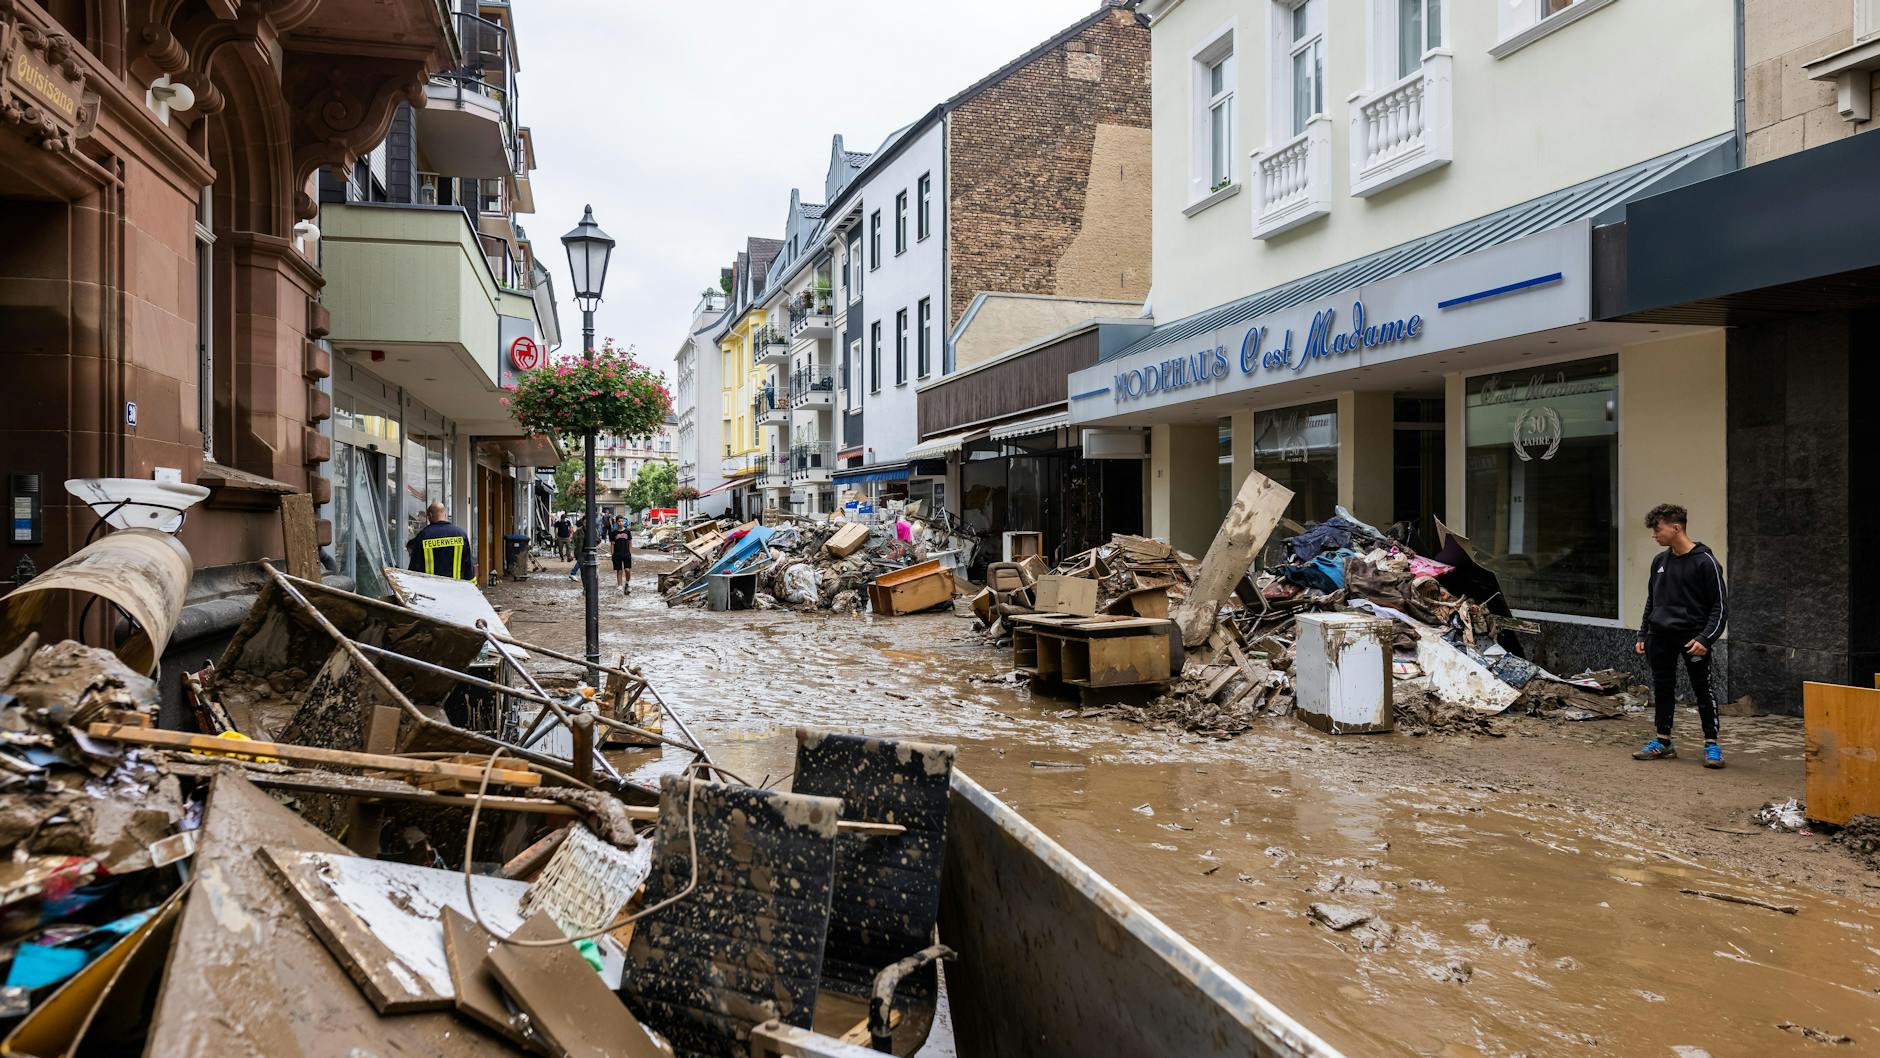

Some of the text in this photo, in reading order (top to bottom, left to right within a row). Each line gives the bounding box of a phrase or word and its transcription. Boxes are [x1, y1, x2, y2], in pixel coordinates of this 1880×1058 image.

[18, 54, 74, 115] Quisisana
[1114, 300, 1421, 401] MODEHAUS C'est Madame
[1528, 415, 1545, 434] 30
[1523, 436, 1551, 447] JAHRE
[424, 538, 462, 547] FEUERWEHR
